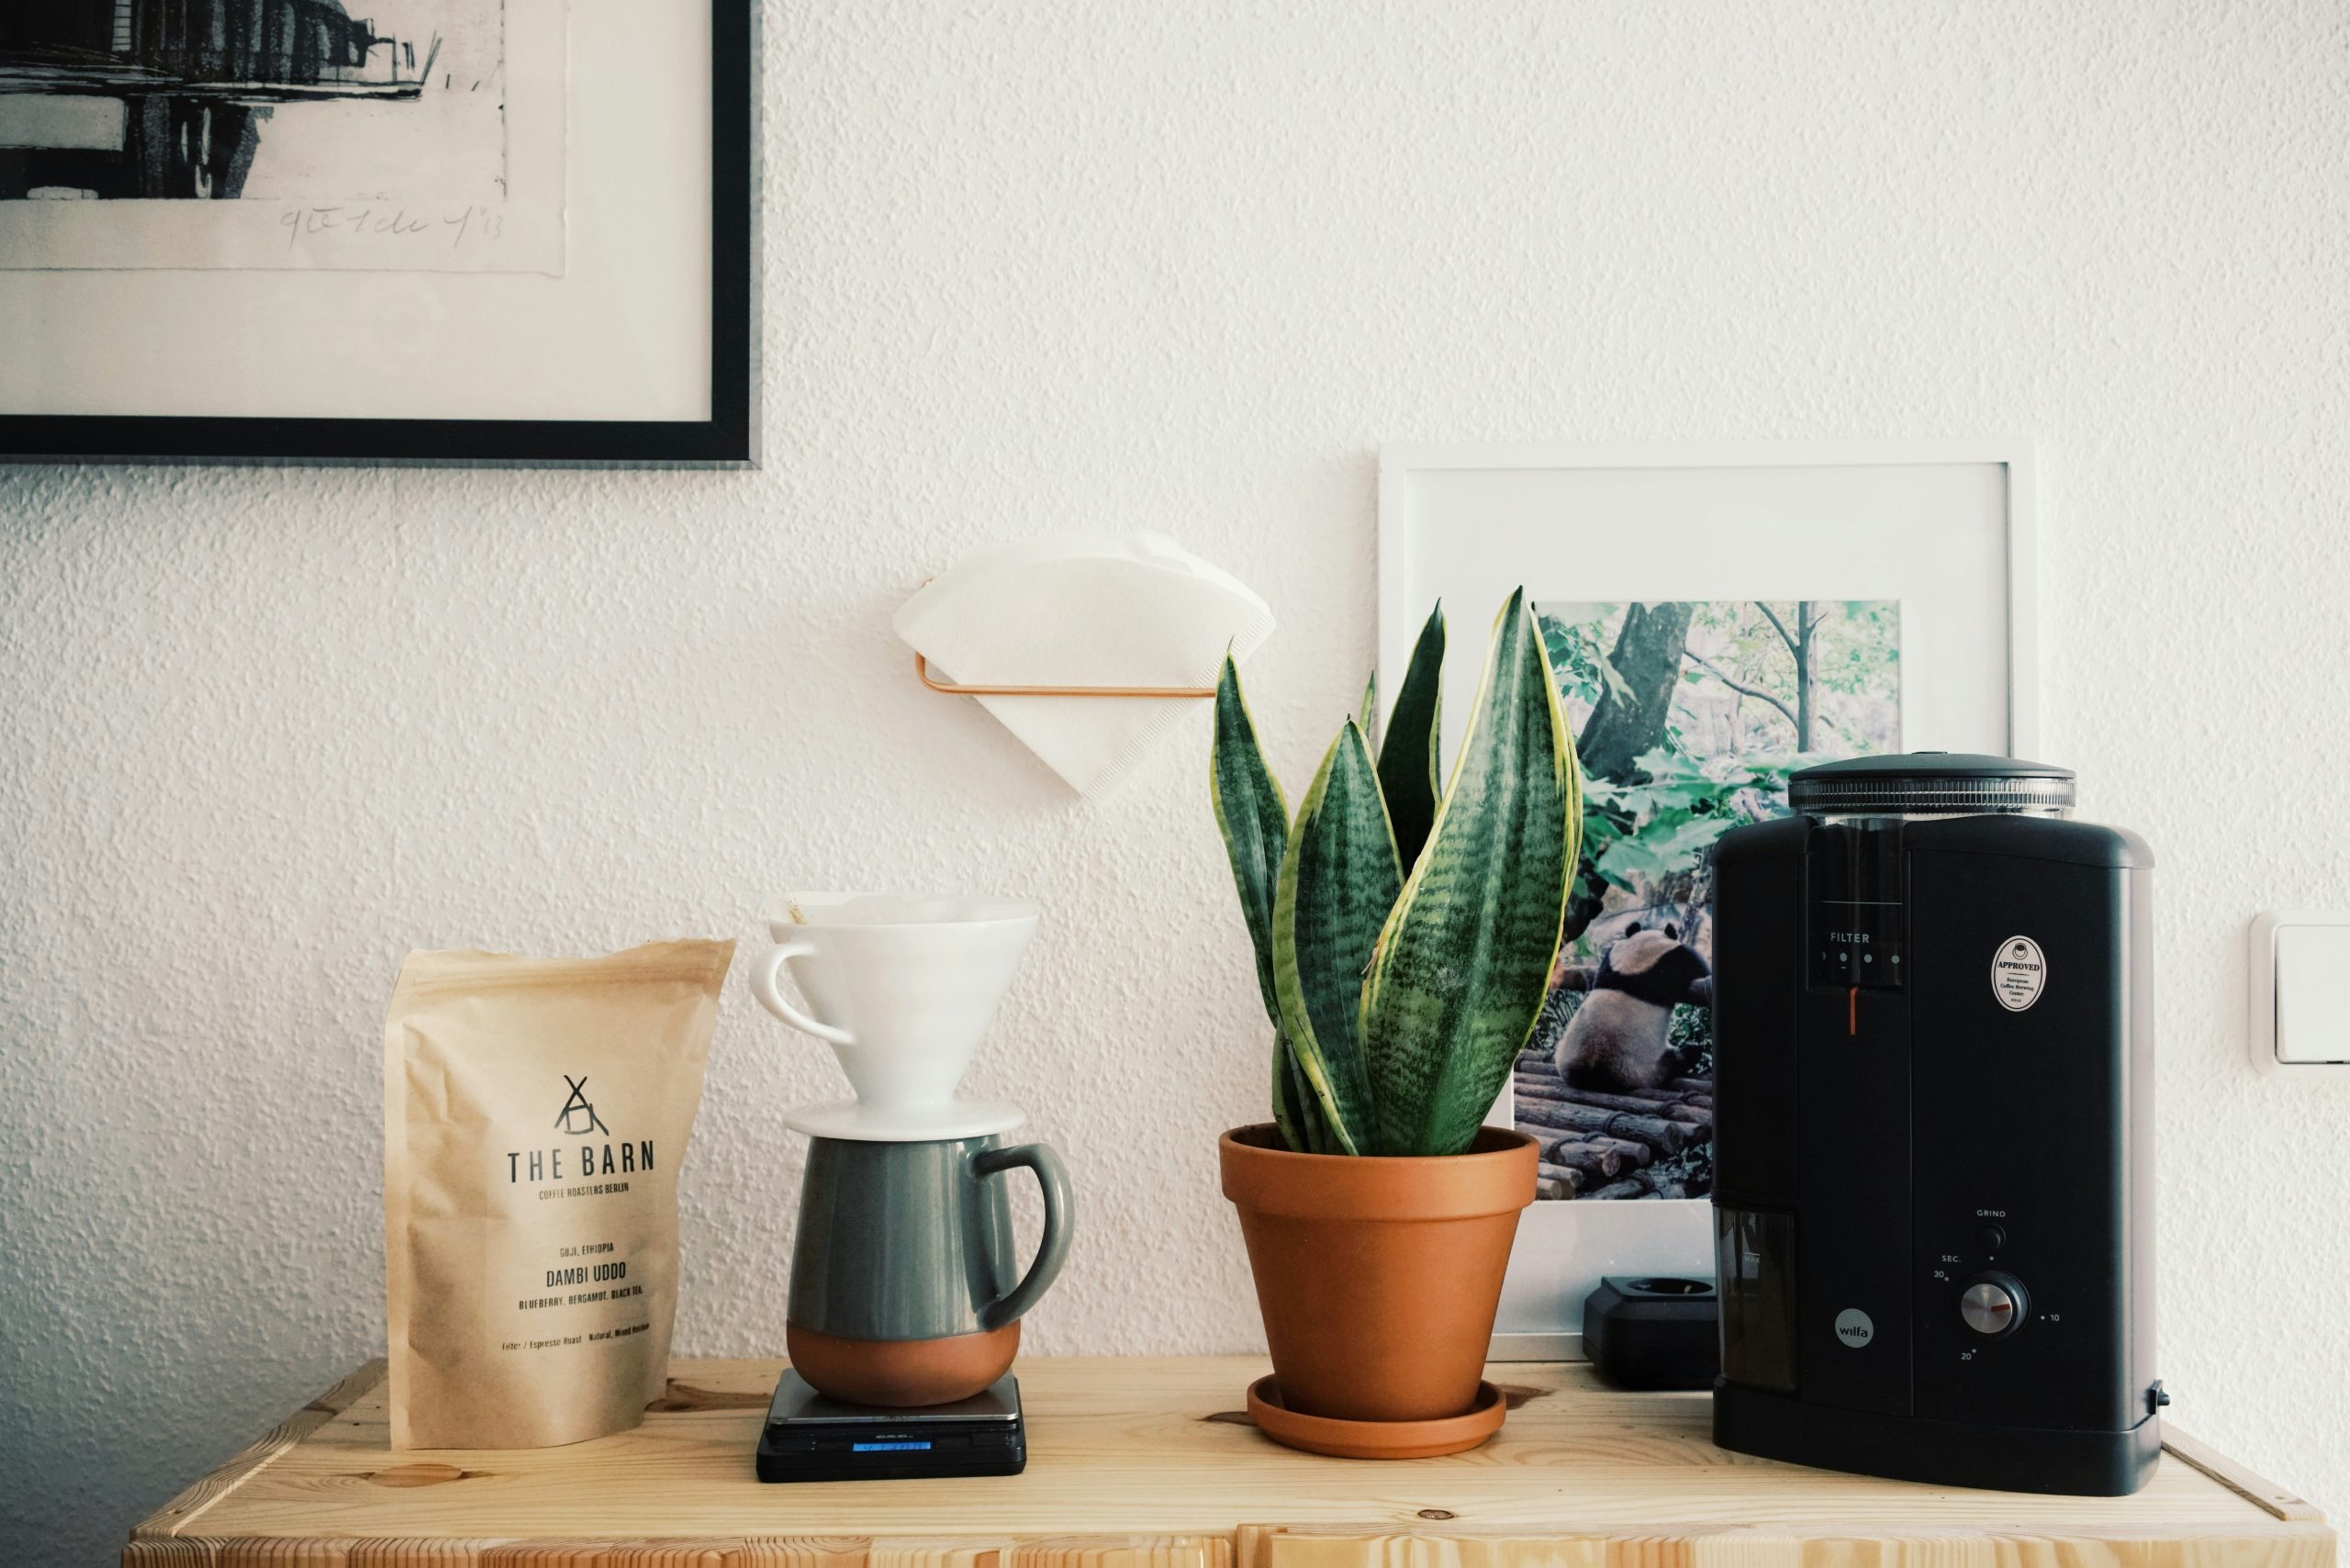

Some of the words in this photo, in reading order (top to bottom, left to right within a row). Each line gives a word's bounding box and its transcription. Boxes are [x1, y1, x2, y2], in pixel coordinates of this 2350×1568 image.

[1830, 932, 1870, 944] FILTER
[1998, 961, 2041, 972] APPROVED
[507, 1148, 563, 1183] THE
[581, 1140, 655, 1177] BARN
[539, 1189, 565, 1201] COFFEE
[567, 1185, 603, 1198] ROASTERS
[605, 1182, 630, 1194] BERLIN
[1976, 1209, 2006, 1217] GRIND
[560, 1248, 580, 1258] GUJI,
[582, 1242, 614, 1255] ETHIOPIA
[1942, 1255, 1962, 1263] SEC.
[546, 1267, 588, 1287] DAMBI
[593, 1261, 626, 1282] UDDO
[610, 1286, 632, 1300] BLACK
[1839, 1326, 1868, 1338] wilfa
[530, 1338, 561, 1350] Espresso
[564, 1336, 582, 1345] Roast
[1961, 1352, 1972, 1361] 20
